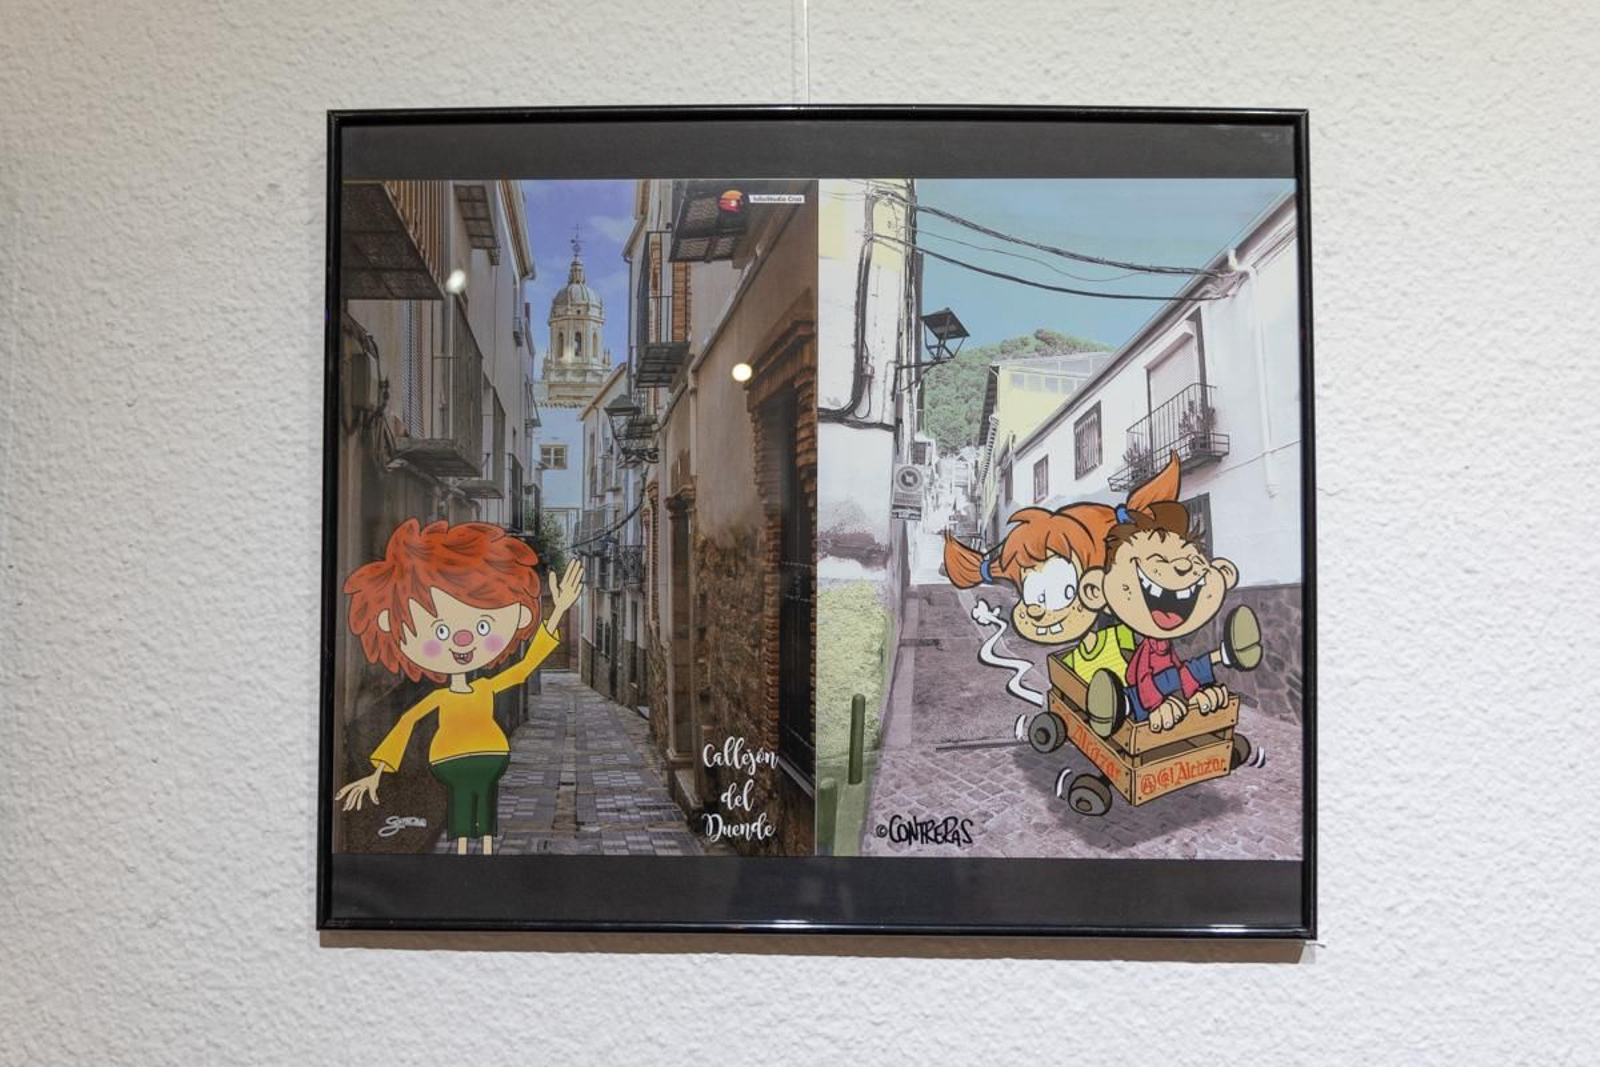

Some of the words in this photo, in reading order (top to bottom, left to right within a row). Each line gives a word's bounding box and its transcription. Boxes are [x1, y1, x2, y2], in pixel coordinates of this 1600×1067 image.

[702, 736, 780, 775] Callejón
[720, 779, 754, 812] del
[701, 812, 777, 842] Duende
